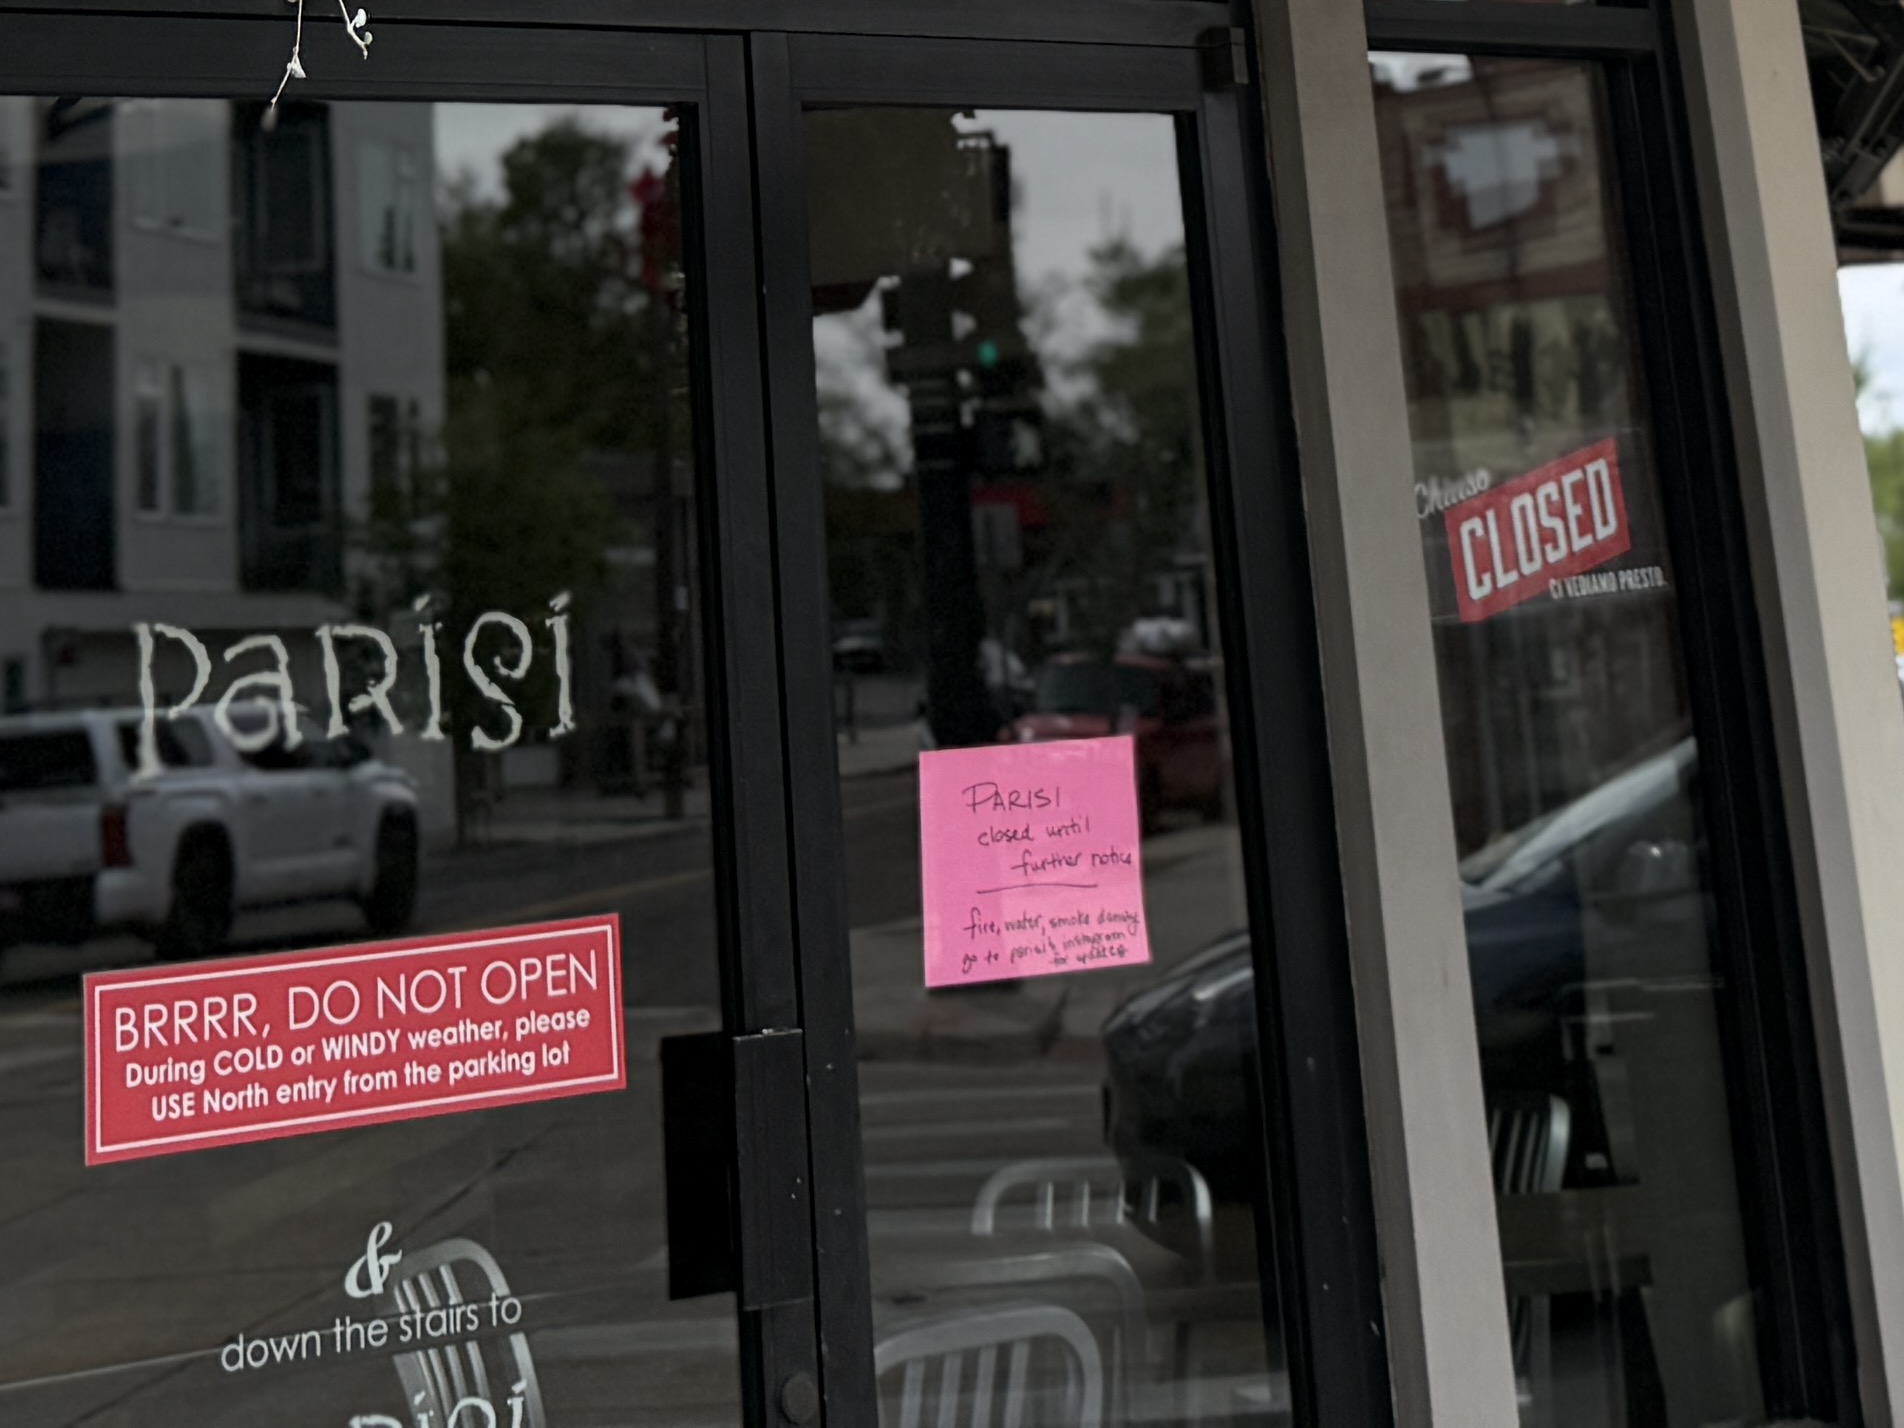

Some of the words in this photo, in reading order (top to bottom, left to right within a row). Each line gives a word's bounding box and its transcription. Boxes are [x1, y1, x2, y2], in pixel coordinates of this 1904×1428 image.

[1460, 458, 1618, 600] CLOSED
[962, 782, 1060, 813] PARISI
[978, 824, 1034, 846] closed
[1046, 816, 1090, 838] until
[1011, 849, 1082, 877] further
[1049, 910, 1089, 930] smoke
[962, 954, 978, 974] go
[985, 949, 999, 963] to
[114, 991, 271, 1052] BRRRR,
[288, 980, 361, 1030] DO
[377, 966, 467, 1020] NOT
[481, 949, 597, 1005] OPEN
[125, 1055, 205, 1089] During
[213, 1045, 283, 1077] COLD
[291, 1045, 316, 1066] or
[321, 1028, 401, 1062] WINDY
[407, 1018, 509, 1050] weather,
[515, 1008, 591, 1041] please
[151, 1091, 196, 1122] USE
[202, 1080, 269, 1115] North
[276, 1074, 338, 1105] entry
[343, 1065, 398, 1096] from
[404, 1059, 442, 1087] the
[448, 1047, 536, 1086] parking
[541, 1039, 571, 1068] lot
[344, 1221, 402, 1298] &
[221, 1332, 321, 1372] down
[334, 1316, 388, 1354] the
[399, 1303, 480, 1344] stairs
[491, 1291, 523, 1326] to
